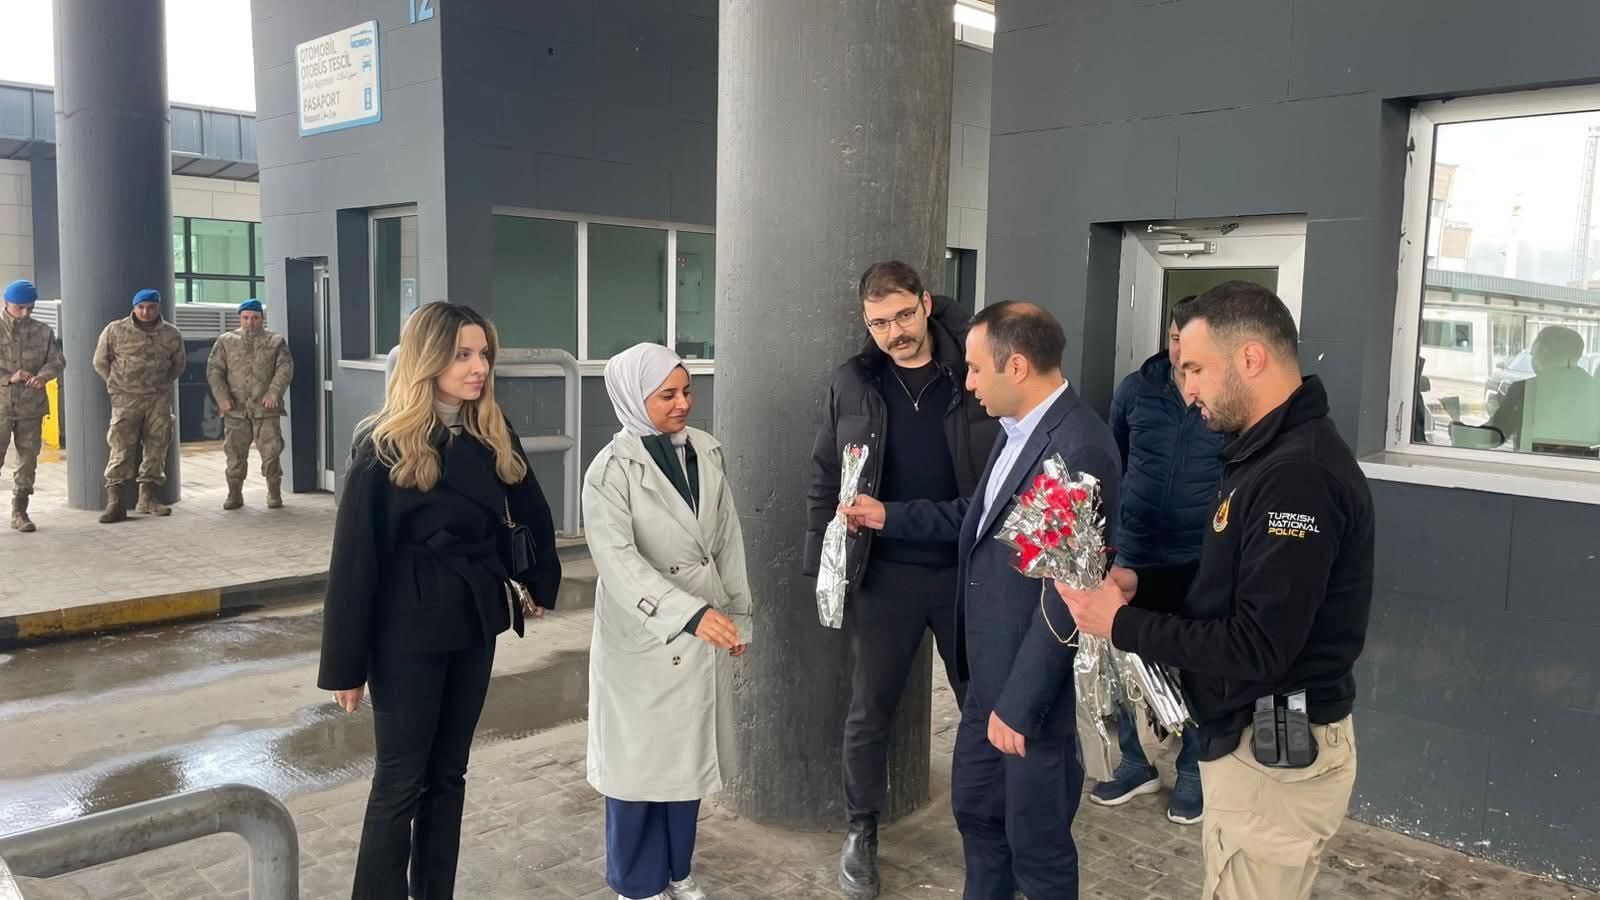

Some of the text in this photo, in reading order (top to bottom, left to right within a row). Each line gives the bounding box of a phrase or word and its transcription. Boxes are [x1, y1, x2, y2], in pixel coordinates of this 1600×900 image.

[303, 91, 340, 112] PASAPORT
[1267, 511, 1315, 524] TURKISH
[1268, 519, 1320, 533] NATIONAL
[1268, 527, 1306, 538] POLICE
